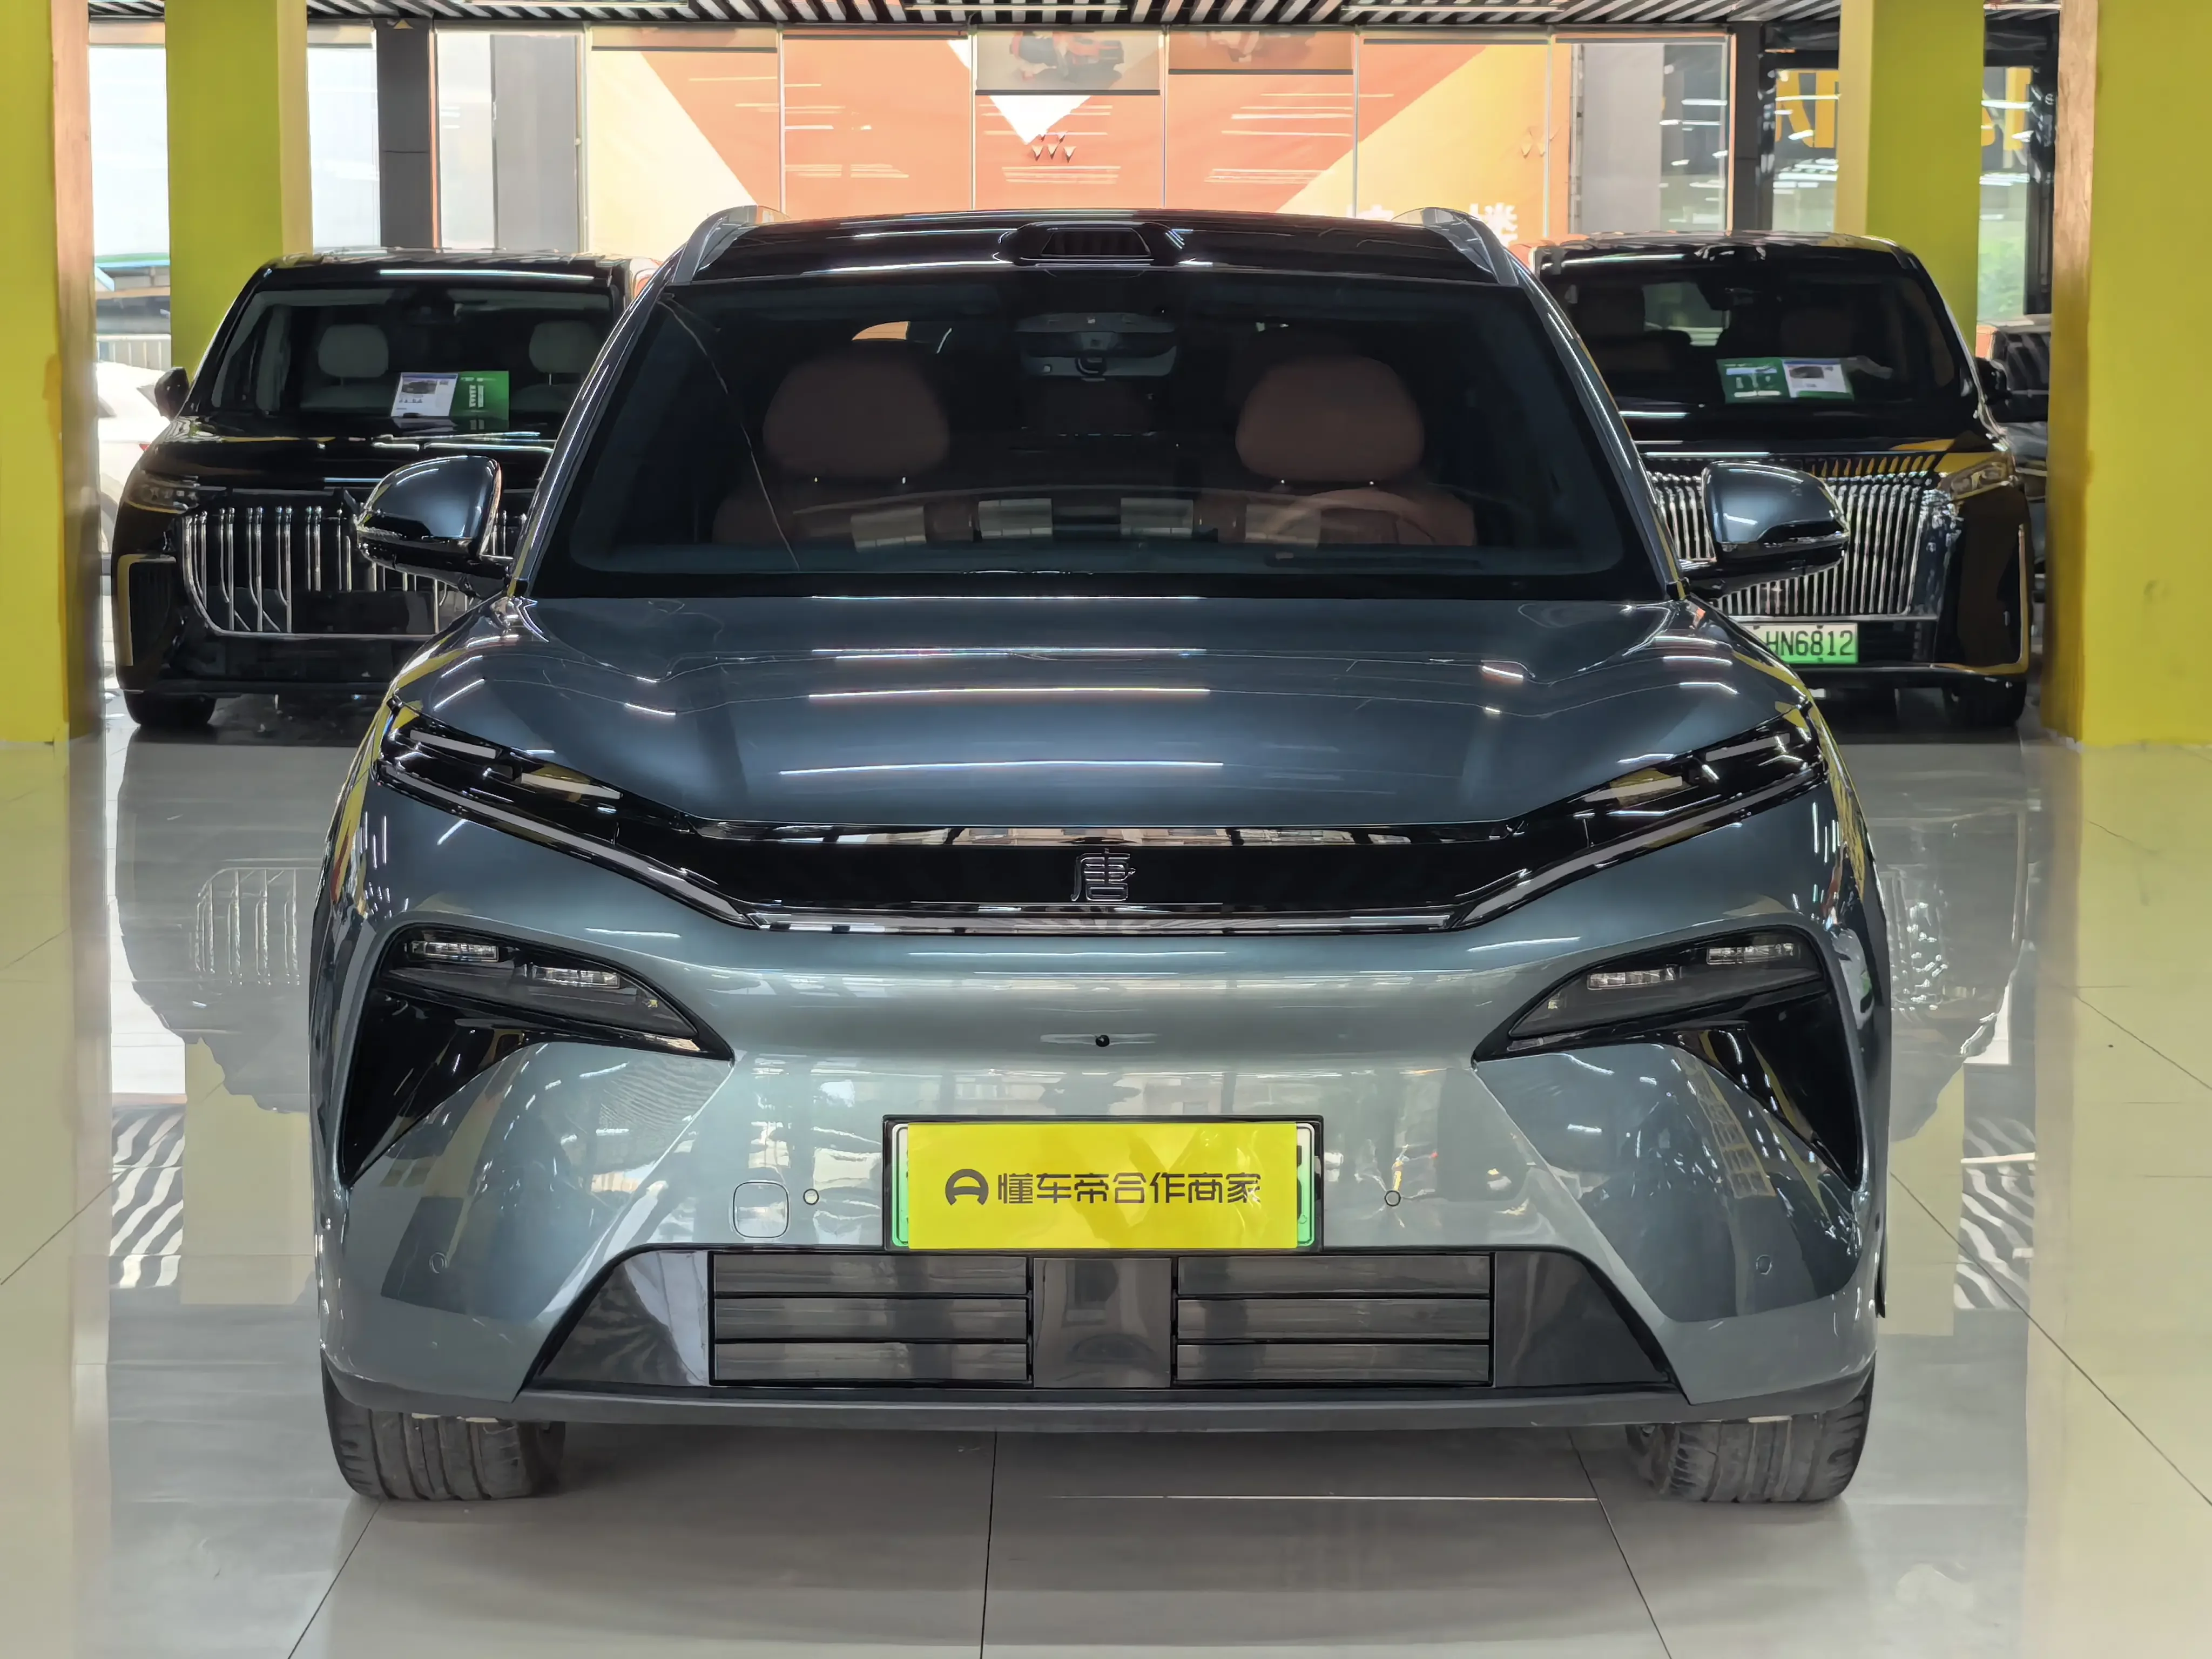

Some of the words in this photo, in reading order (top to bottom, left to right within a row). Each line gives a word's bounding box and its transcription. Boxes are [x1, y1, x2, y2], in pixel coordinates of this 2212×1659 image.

[1071, 848, 1136, 901] 唐
[998, 1172, 1261, 1204] 懂车帝合作商家
